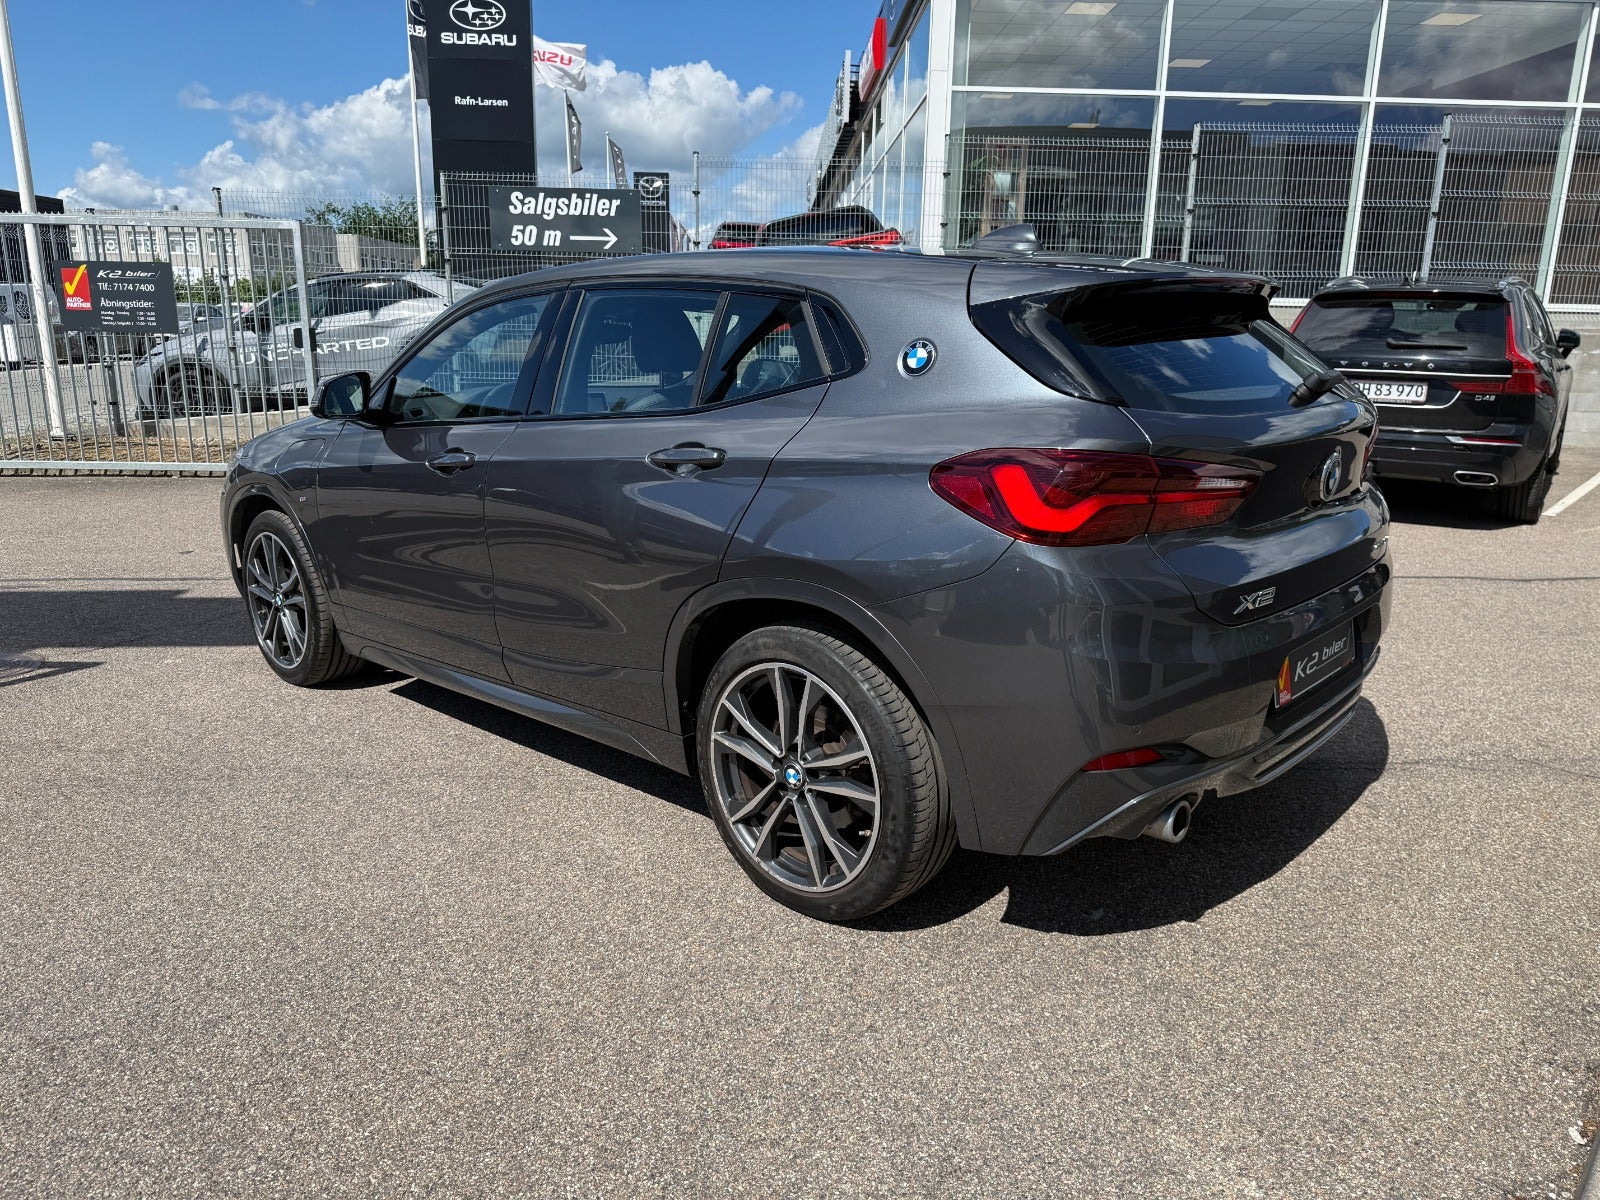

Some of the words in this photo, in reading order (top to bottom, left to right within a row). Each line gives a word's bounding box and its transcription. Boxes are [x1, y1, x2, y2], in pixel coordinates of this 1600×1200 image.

[440, 32, 517, 46] SUBARU
[454, 96, 509, 107] Rafn-Larsen
[509, 191, 621, 220] Salgsbiler
[510, 224, 537, 246] 50
[543, 229, 561, 246] m
[97, 270, 121, 278] K2
[97, 282, 112, 291] Tlf.:
[113, 282, 133, 291] 7174
[135, 282, 155, 292] 7400
[101, 297, 154, 309] Åbningstider:
[1374, 383, 1392, 397] 83
[1396, 384, 1424, 398] 970
[1233, 586, 1276, 615] X2
[1294, 651, 1319, 682] K2
[1322, 636, 1348, 661] biler
